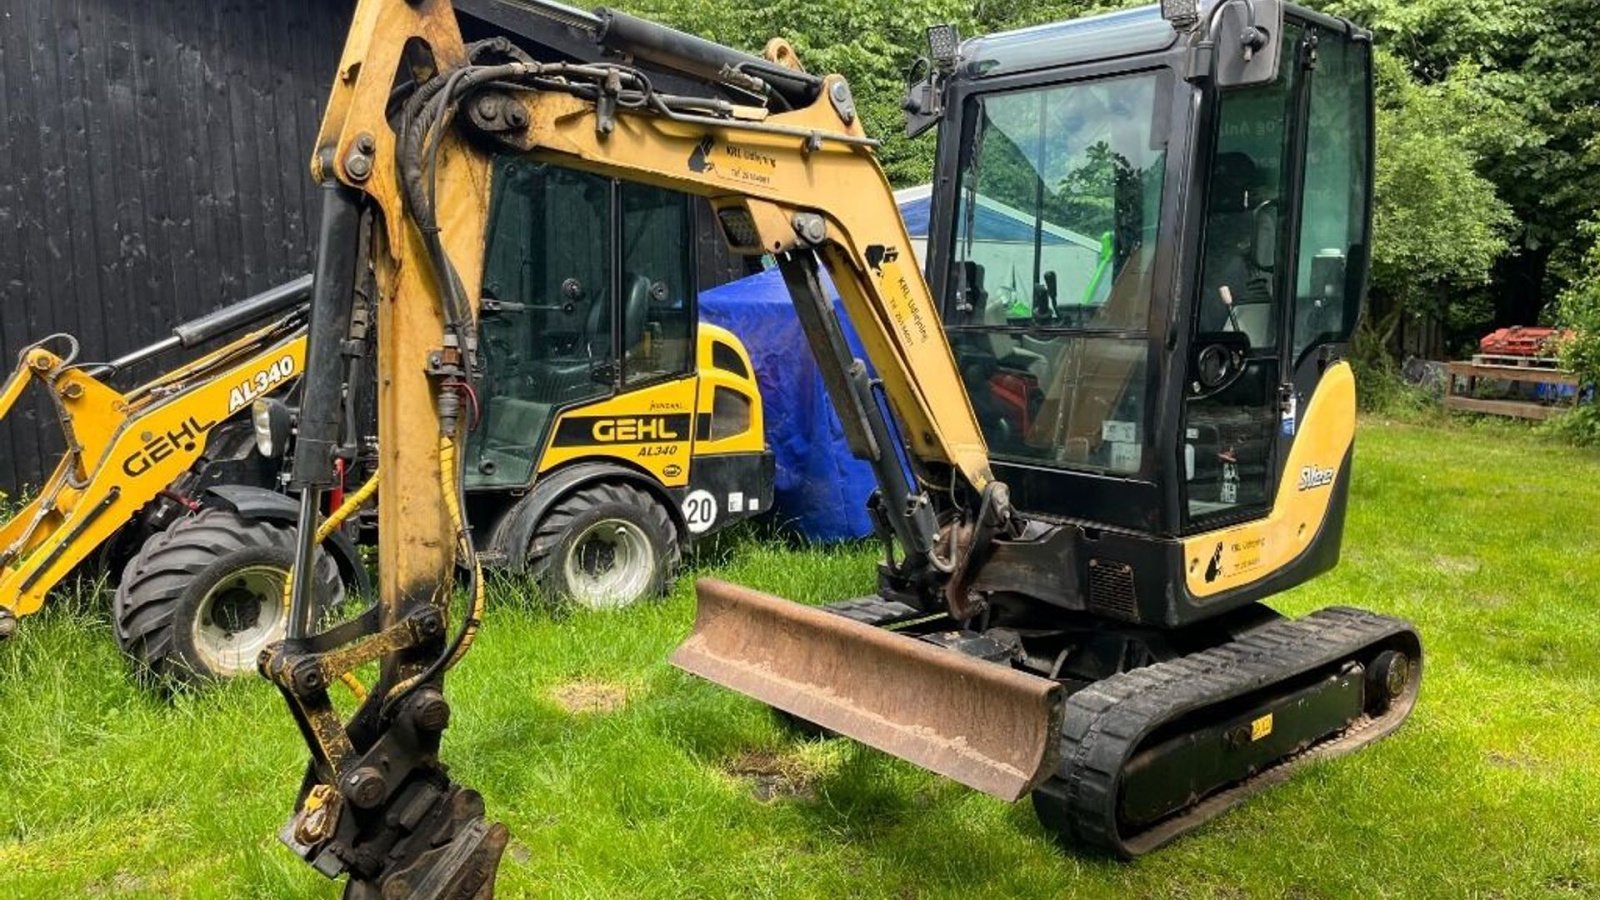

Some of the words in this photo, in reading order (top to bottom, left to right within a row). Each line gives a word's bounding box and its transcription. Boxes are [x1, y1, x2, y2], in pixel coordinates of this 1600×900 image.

[228, 355, 295, 414] AL340
[592, 418, 678, 442] GEHL
[122, 416, 217, 478] GEHL
[637, 444, 678, 457] AL340
[687, 498, 712, 525] 20
